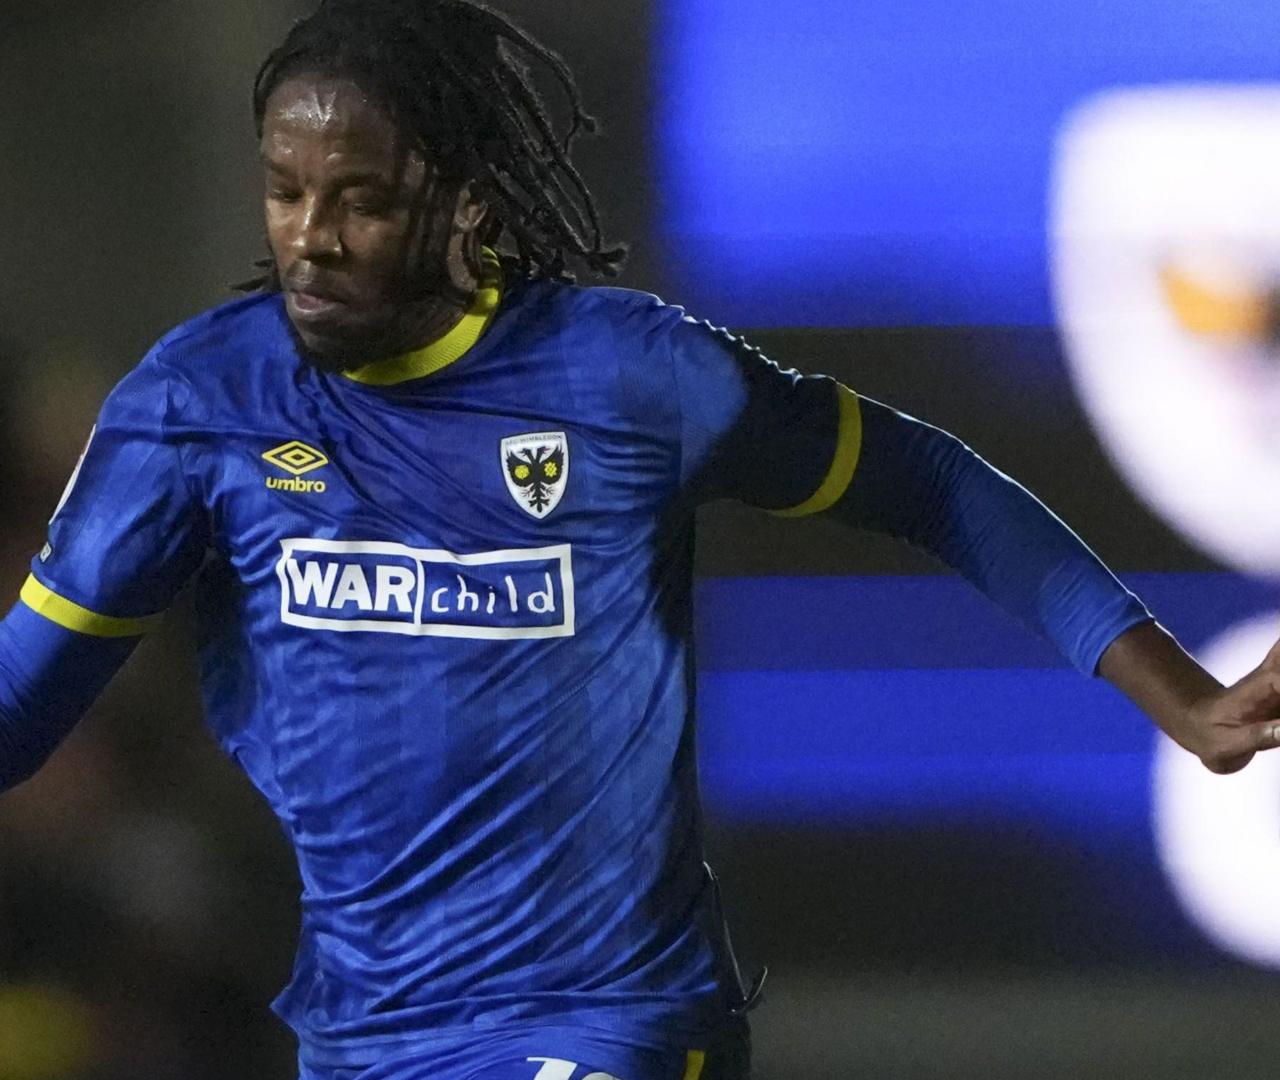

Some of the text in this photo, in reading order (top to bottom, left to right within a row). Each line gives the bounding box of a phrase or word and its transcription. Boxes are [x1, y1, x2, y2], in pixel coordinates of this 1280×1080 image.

[266, 476, 326, 493] umbro
[287, 558, 556, 615] WAR child
